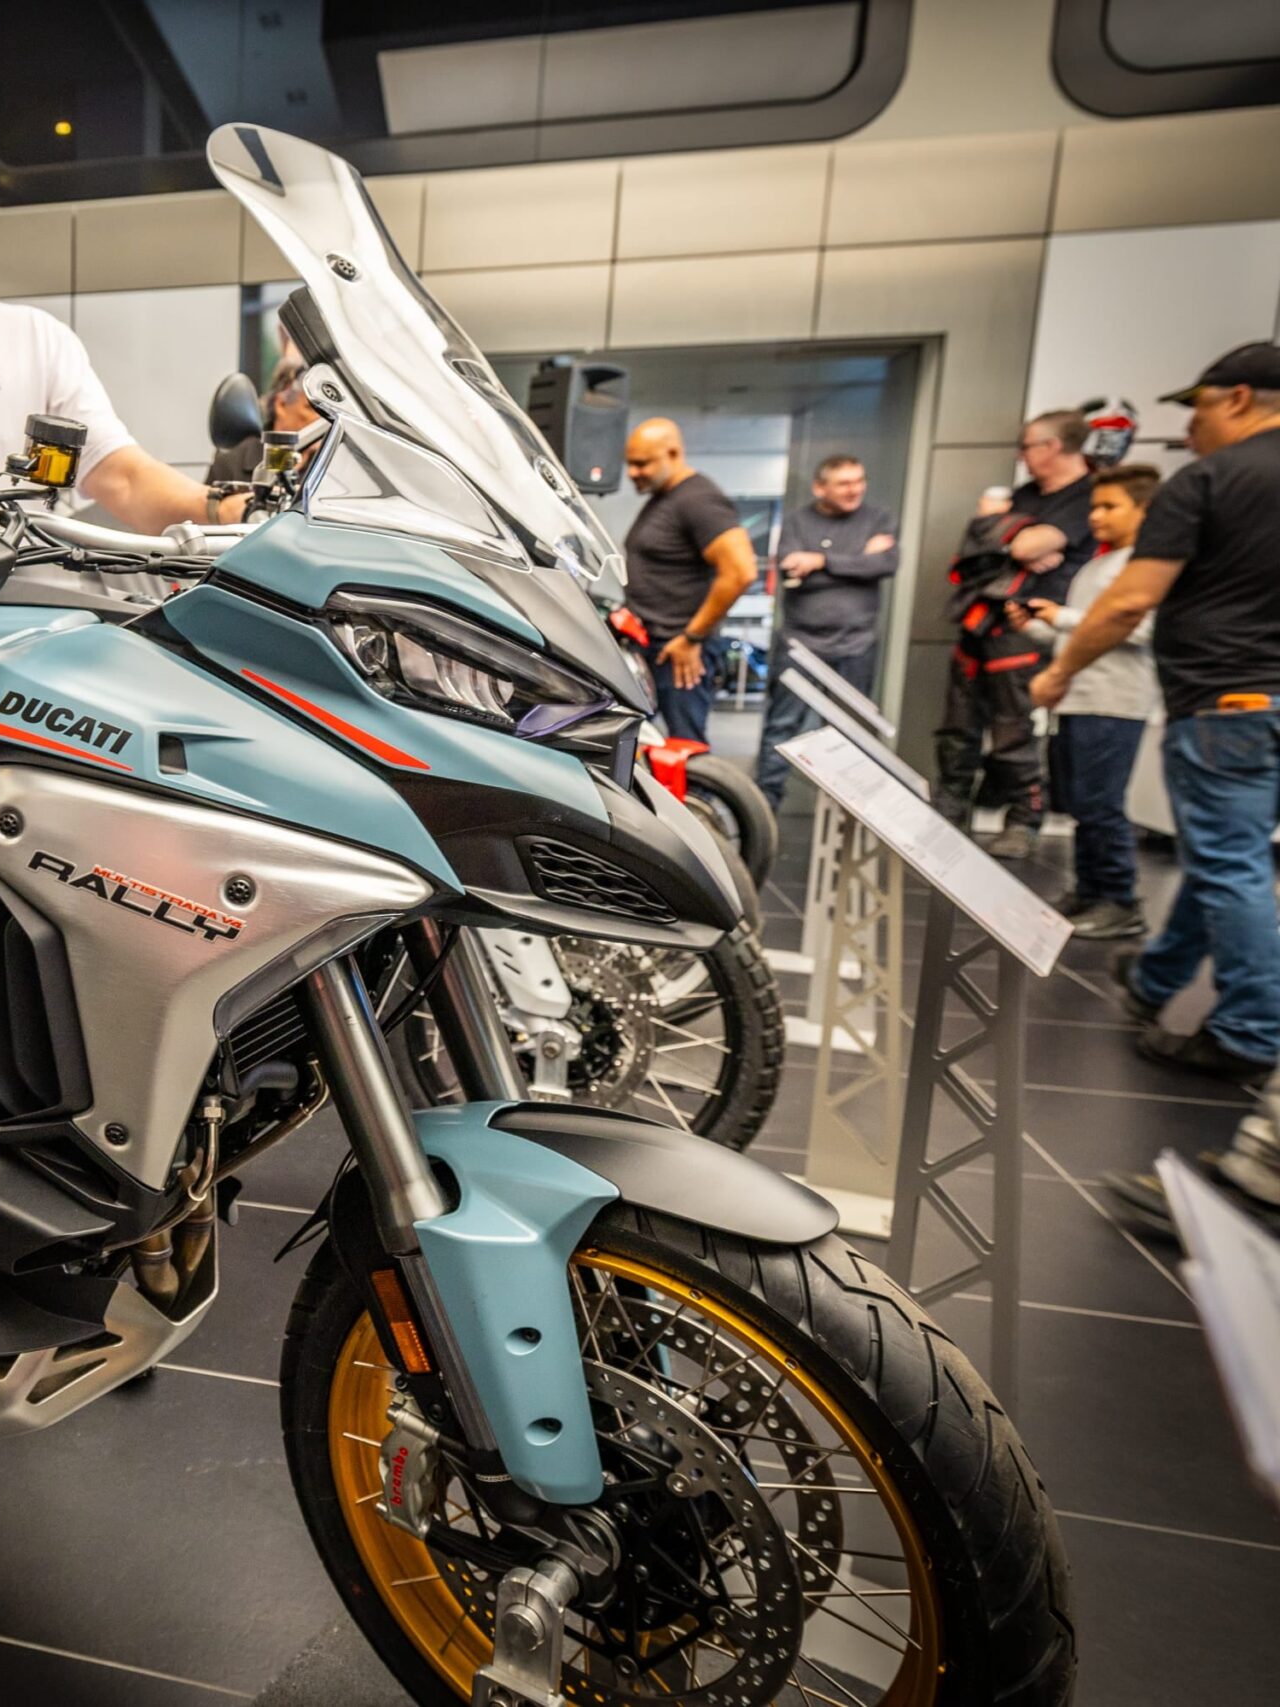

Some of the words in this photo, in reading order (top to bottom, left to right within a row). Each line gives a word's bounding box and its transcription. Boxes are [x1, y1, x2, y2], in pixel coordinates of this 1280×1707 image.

[27, 850, 241, 941] RALLY
[92, 866, 218, 920] MULTISTRADA
[221, 915, 244, 929] V4
[390, 1447, 409, 1505] brembo
